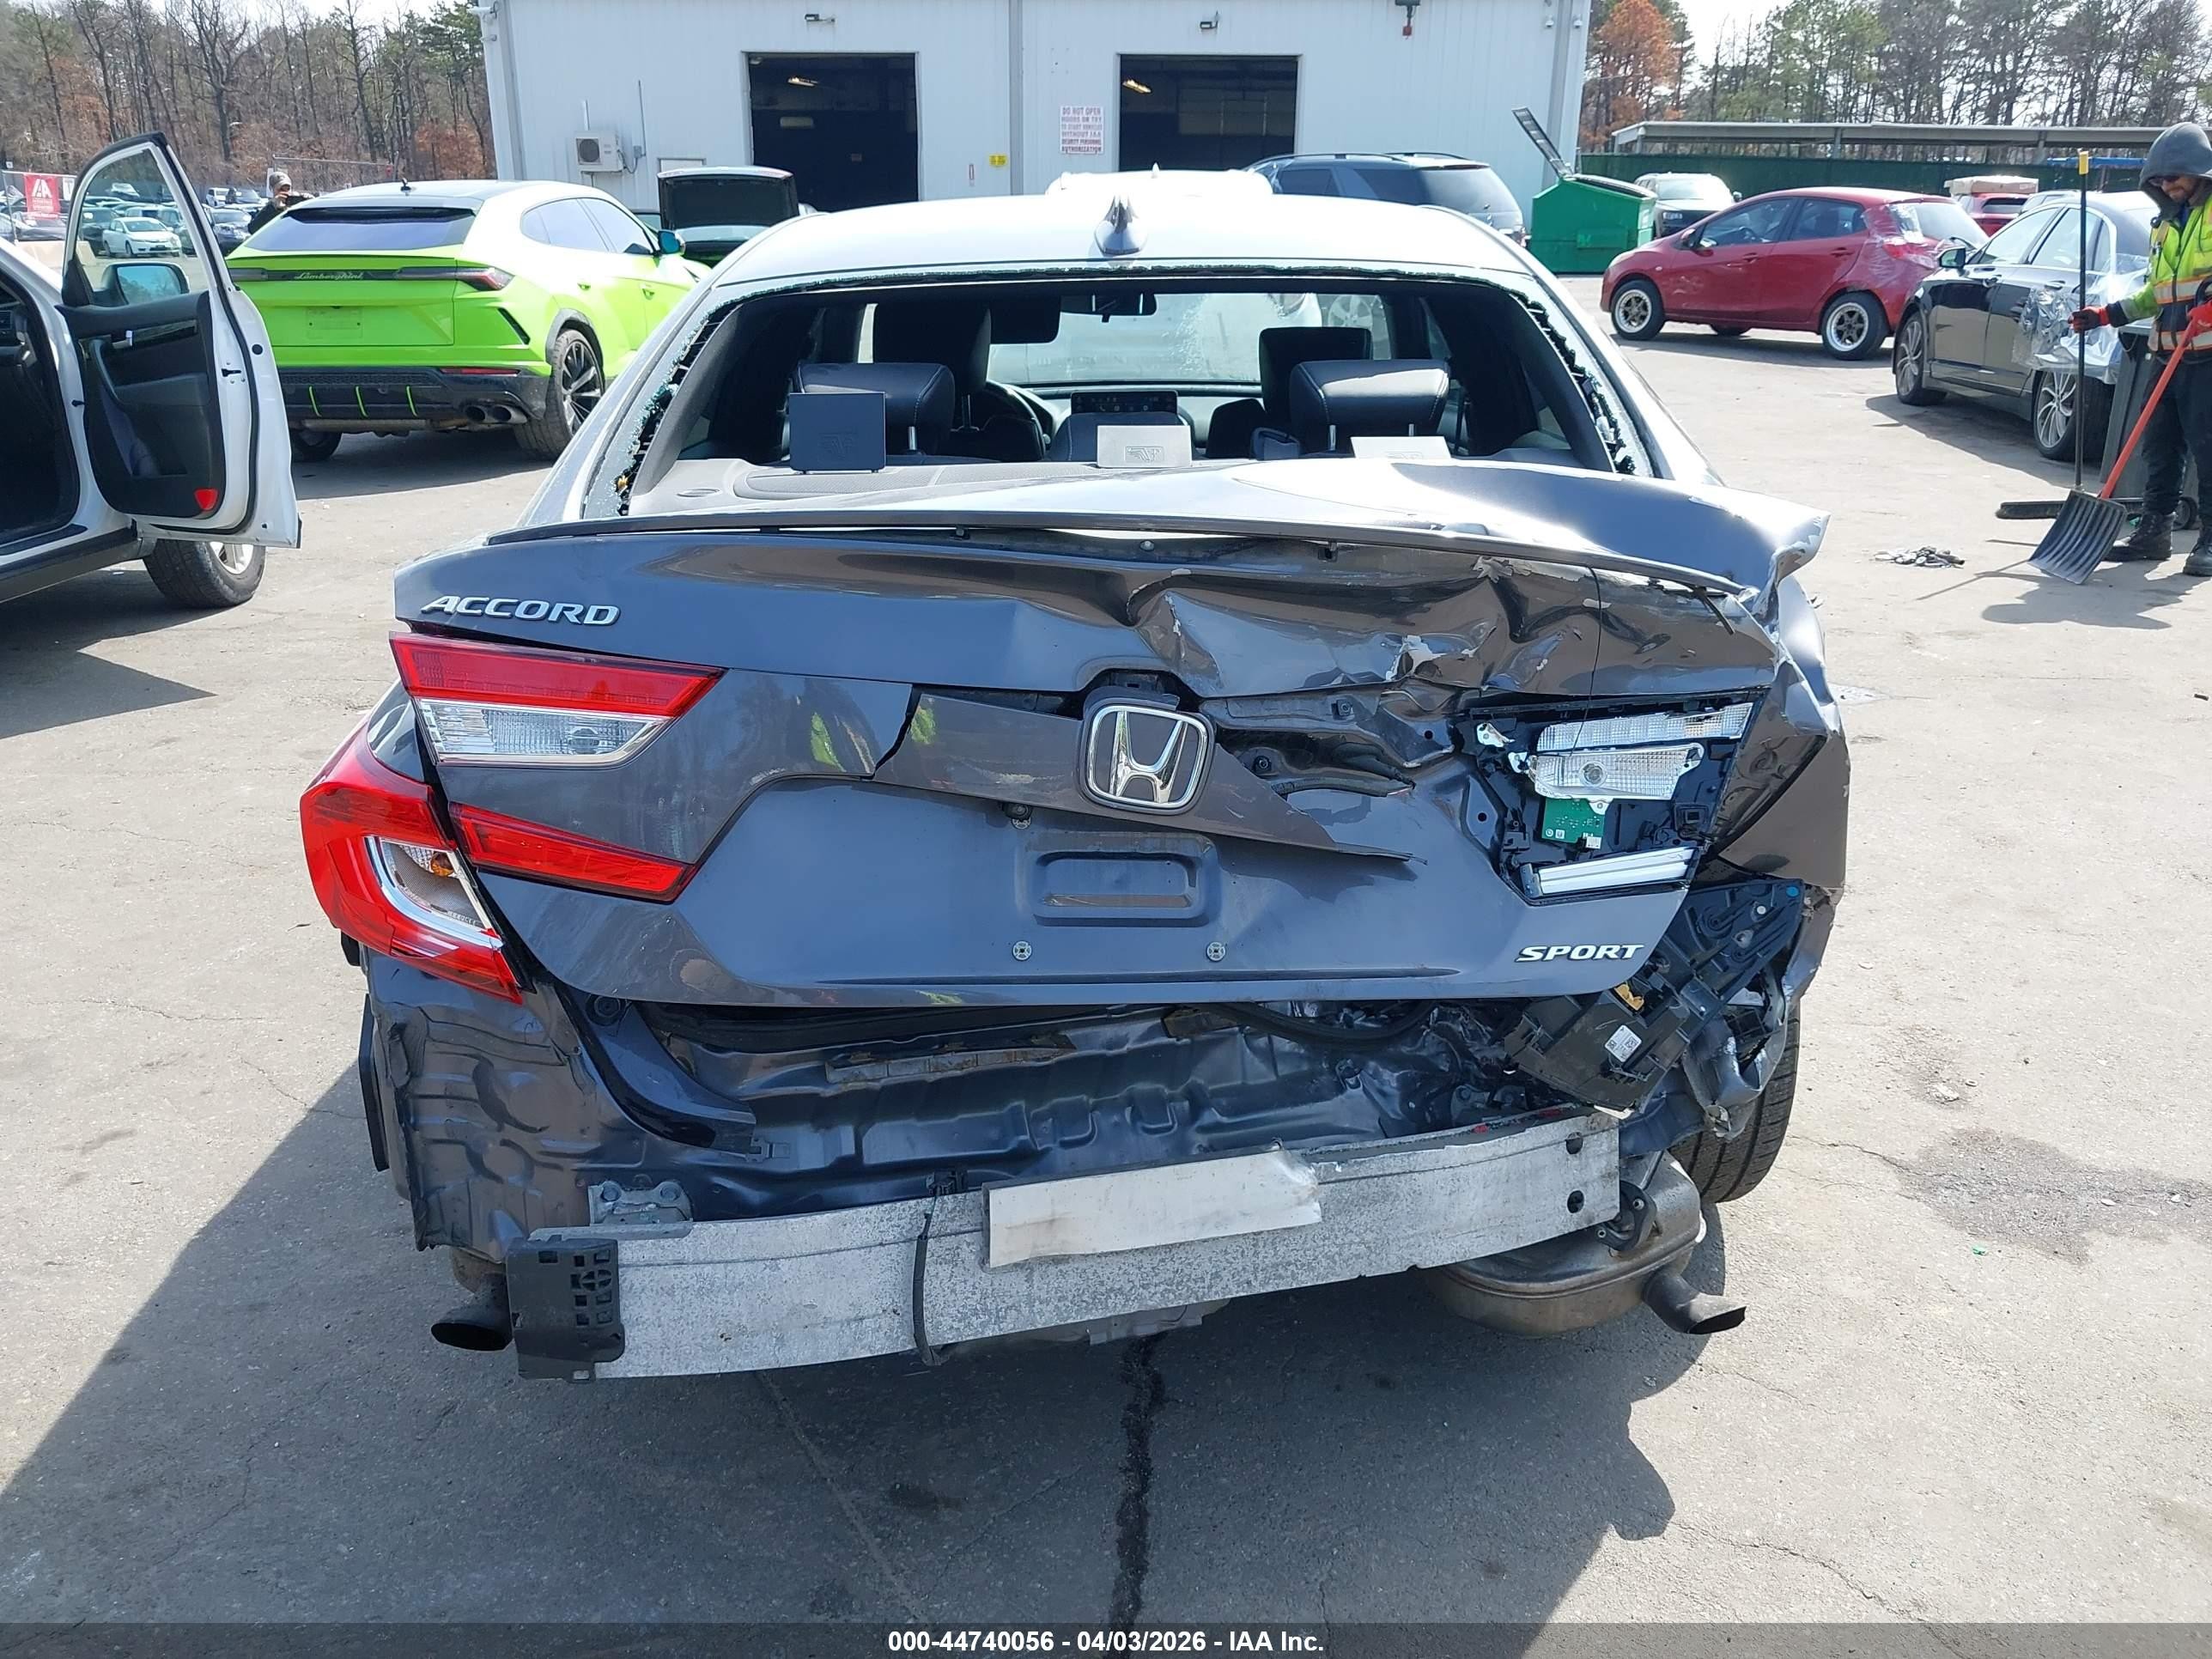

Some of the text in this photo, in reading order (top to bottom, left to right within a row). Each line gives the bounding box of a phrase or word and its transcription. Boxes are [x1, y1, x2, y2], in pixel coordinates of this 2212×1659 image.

[1085, 106, 1101, 115] OPEN
[421, 595, 622, 626] ACCORD
[1515, 944, 1645, 963] SPORT
